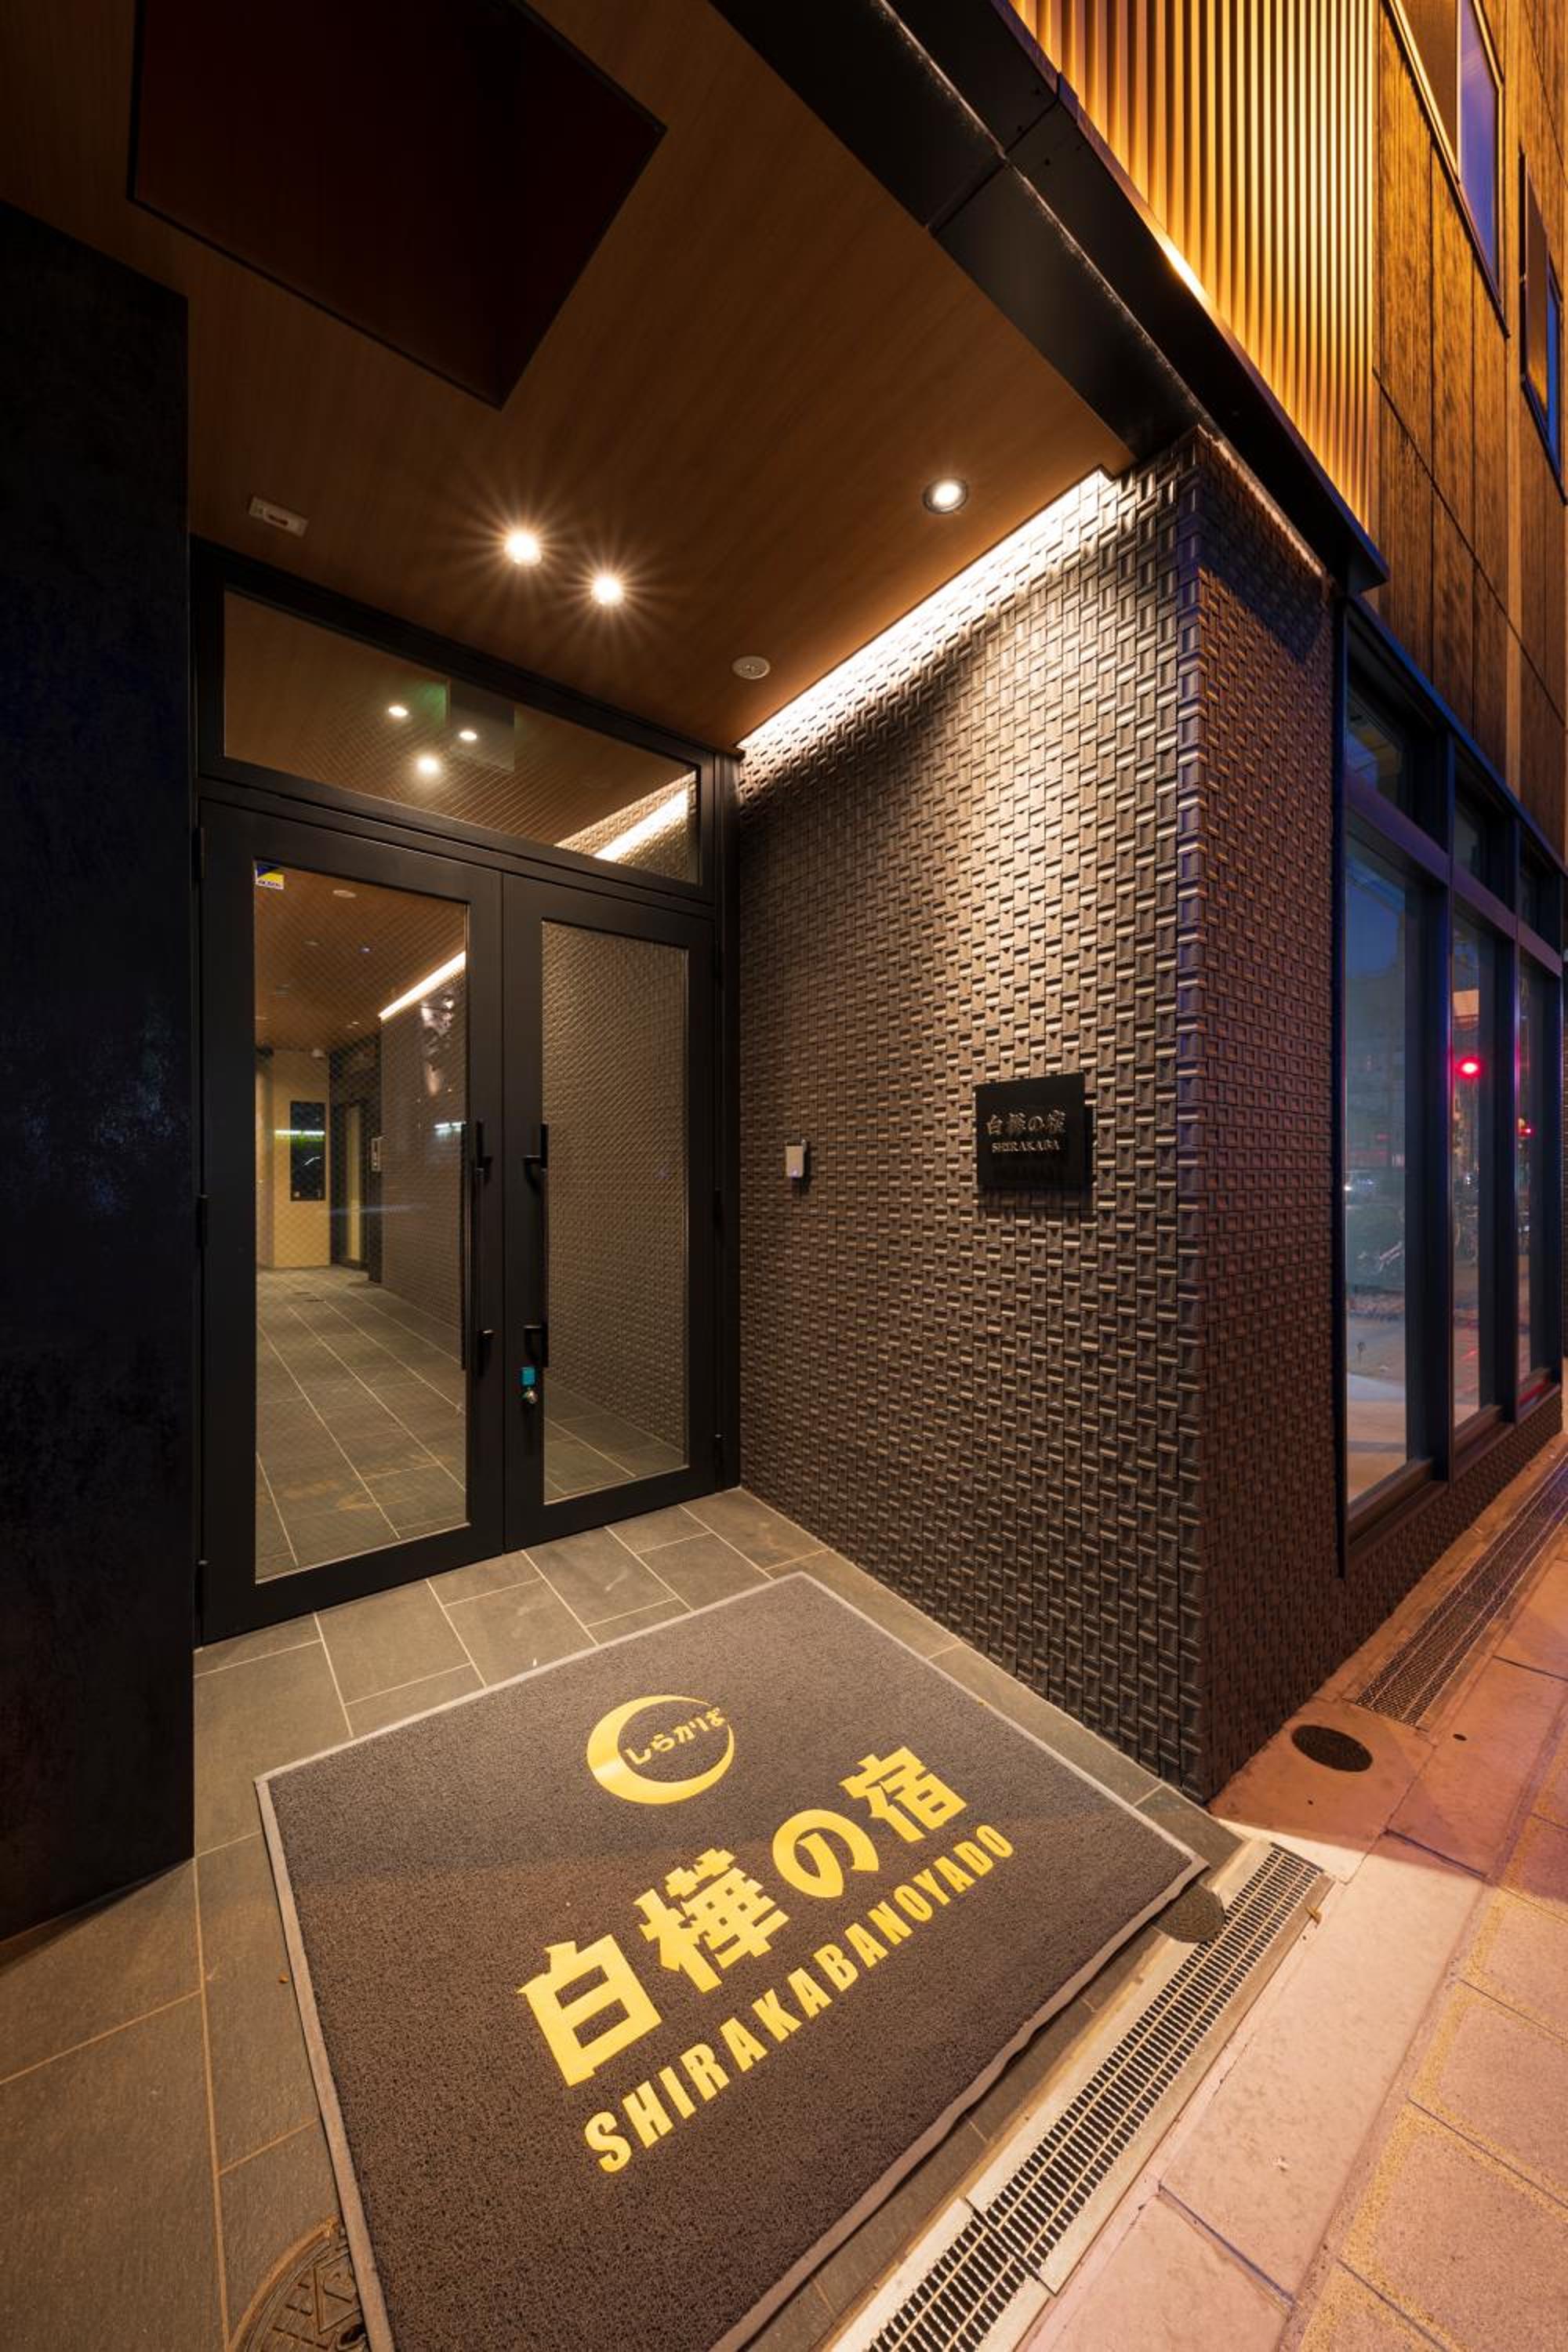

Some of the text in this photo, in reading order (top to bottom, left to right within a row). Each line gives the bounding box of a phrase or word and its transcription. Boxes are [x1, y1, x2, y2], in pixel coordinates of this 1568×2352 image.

[625, 1707, 725, 1765] しらかば
[517, 1747, 967, 2087] 白樺の宿
[584, 1824, 1014, 2172] SHIRAKABANOYADO
